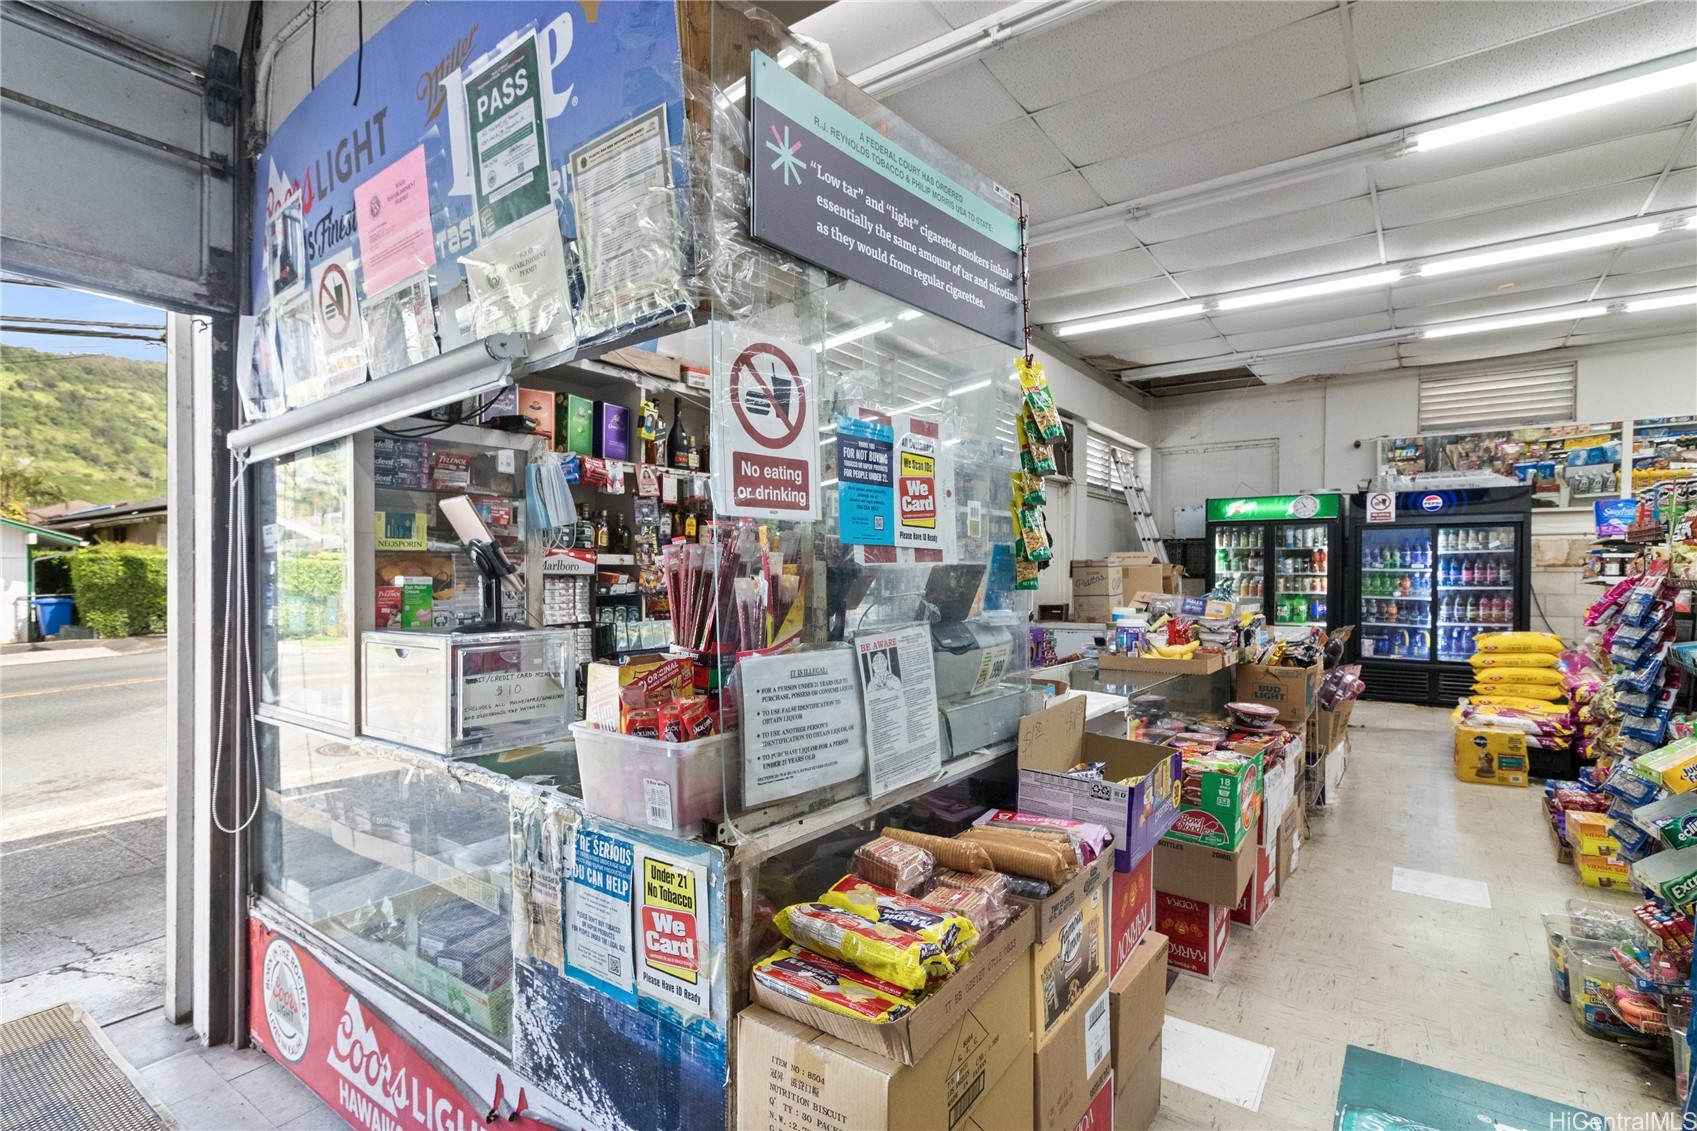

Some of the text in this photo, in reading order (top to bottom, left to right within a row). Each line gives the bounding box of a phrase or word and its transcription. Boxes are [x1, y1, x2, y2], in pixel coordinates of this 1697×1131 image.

[416, 23, 478, 115] Miller
[476, 68, 528, 123] PASS
[315, 106, 388, 201] LIGHT
[814, 116, 994, 233] R.J. REYNOLDS TOBACCO & PHILIP MORRIS USA TO STATE:
[859, 132, 963, 203] A FEDERAL COURT HAS ORDERED
[865, 195, 884, 214] and
[919, 224, 957, 253] cigarette
[957, 245, 990, 269] smokers
[990, 259, 1013, 281] inhale
[816, 195, 1018, 304] essentially the same amount of tar and nicotine
[509, 251, 547, 272] ESTABLISHMENT
[816, 221, 986, 309] as they would from regular cigarettes.
[519, 265, 538, 277] PERMIT
[901, 438, 909, 447] All
[439, 455, 467, 465] TYLENOL
[843, 447, 888, 464] FOR NOT BUYING
[741, 460, 802, 485] No eating
[903, 457, 932, 473] We Scan IDs
[843, 468, 882, 481] FOR PEOPLE UNDER
[737, 485, 807, 506] or drinking
[905, 480, 929, 496] We
[901, 495, 934, 512] Card
[378, 540, 423, 548] NEOSPORIN
[899, 531, 938, 543] Please Have Ready
[860, 643, 871, 653] BE
[873, 638, 897, 650] AWARE
[647, 661, 679, 683] ORIGINAL
[803, 667, 828, 675] ILLEGAL:
[761, 680, 834, 695] FOR PERSON UNDER YEARS
[761, 686, 840, 703] PURCHASE, POSSESS CONSUME
[1258, 684, 1281, 693] BUD
[1254, 692, 1285, 701] LIGHT
[464, 703, 492, 713] INCLUDES
[781, 705, 797, 714] FALSE
[797, 700, 834, 712] IDENTIFICATION
[762, 713, 803, 725] OBTAIN LIQUOR
[770, 729, 781, 737] USE
[781, 726, 806, 736] ANOTHER
[807, 722, 829, 733] PERSON'S
[761, 729, 831, 748] IDENTIFICATION OBTAIN
[770, 749, 798, 759] PURCHASE
[798, 744, 818, 754] LIQUOR
[818, 742, 829, 750] FOR
[832, 738, 849, 747] PERSON
[762, 753, 816, 770] UNDER YEARS OLD
[1219, 777, 1231, 786] 18
[1181, 813, 1204, 827] Bowl
[1176, 821, 1215, 838] Noodles
[1585, 831, 1609, 840] VIENNA
[593, 839, 632, 866] SERIOUS
[1211, 851, 1233, 861] 200ML
[1587, 863, 1612, 872] VIENNA
[586, 867, 603, 888] CAN
[606, 874, 629, 897] HELP
[651, 864, 676, 884] Under
[677, 873, 688, 890] 21
[647, 882, 693, 910] No Tobacco
[605, 923, 621, 934] TOBACCO
[651, 911, 686, 937] We
[645, 930, 694, 960] Card
[1168, 941, 1207, 963] KARKO
[273, 976, 298, 1013] Coors
[643, 971, 701, 1005] Please Have ID Ready
[276, 1000, 294, 1024] LIGHT
[335, 1013, 410, 1110] Coors
[771, 1055, 825, 1085] ITEM 8504
[769, 1082, 848, 1124] NUTRITION BISCUIT
[801, 1112, 813, 1124] 30
